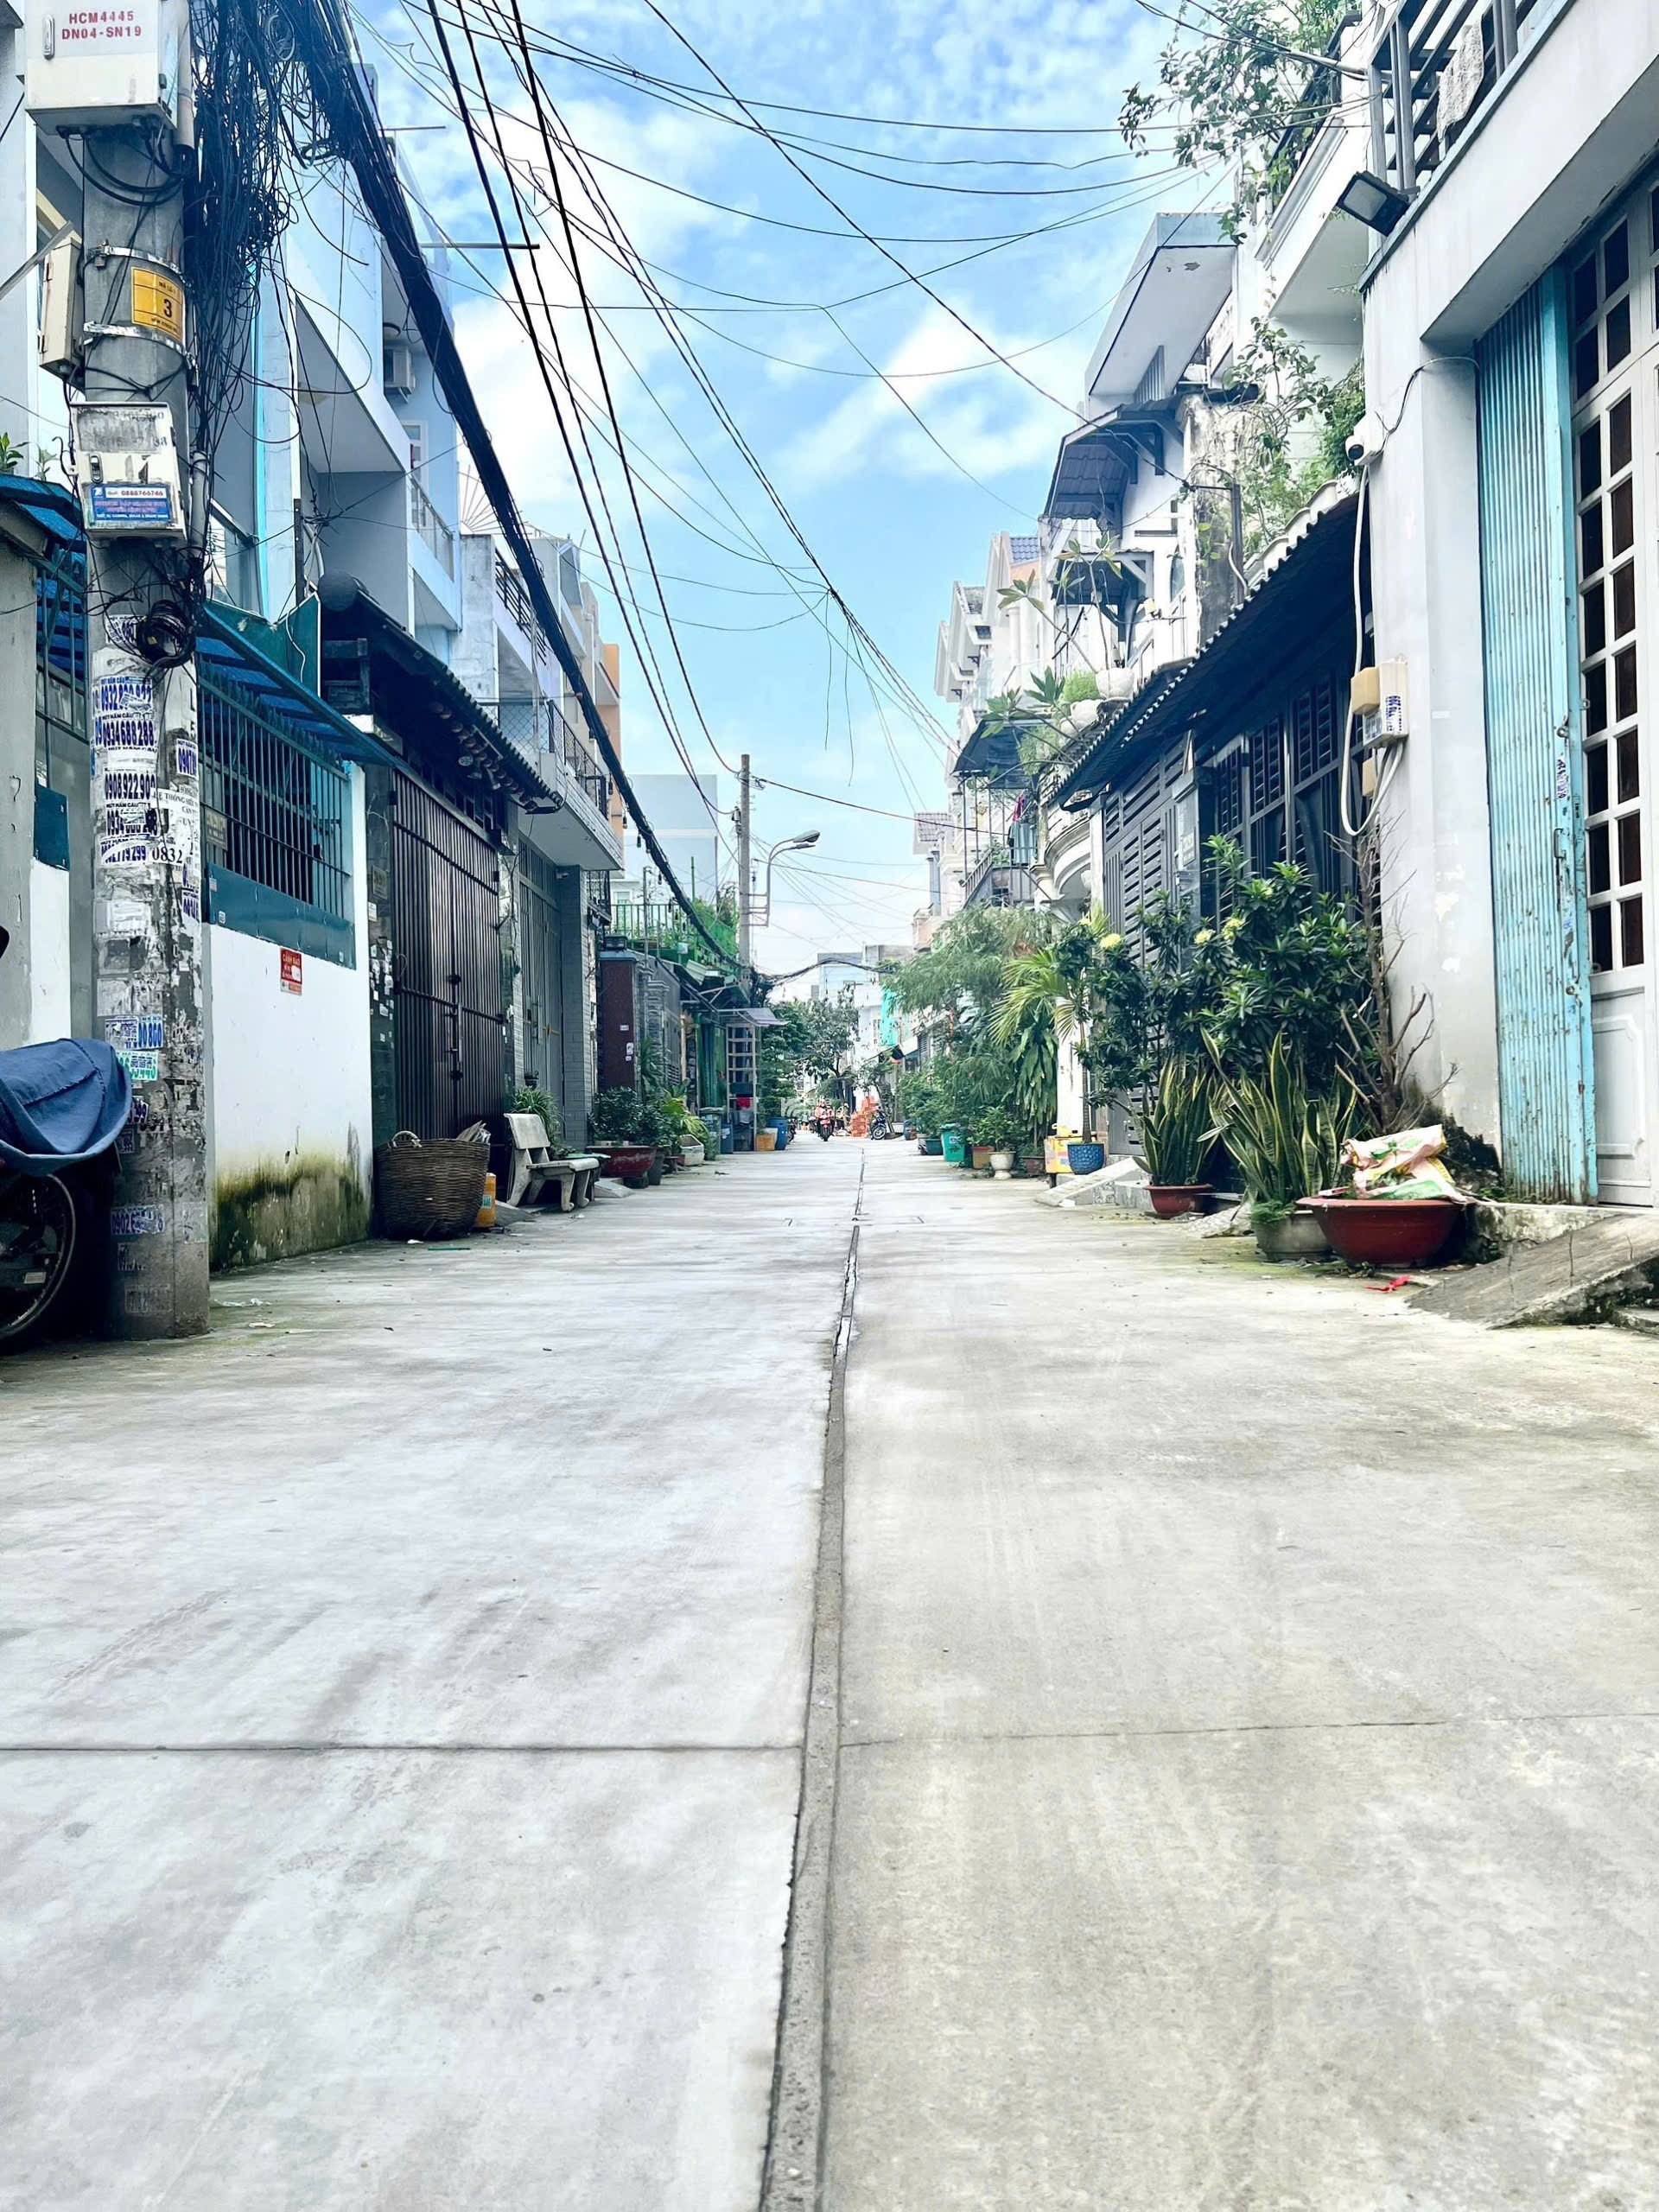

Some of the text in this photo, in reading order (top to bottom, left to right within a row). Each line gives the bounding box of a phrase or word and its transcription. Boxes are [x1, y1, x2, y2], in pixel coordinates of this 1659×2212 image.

[69, 10, 134, 24] HCM4445
[61, 26, 142, 40] DN04-SN19
[163, 298, 173, 318] 3
